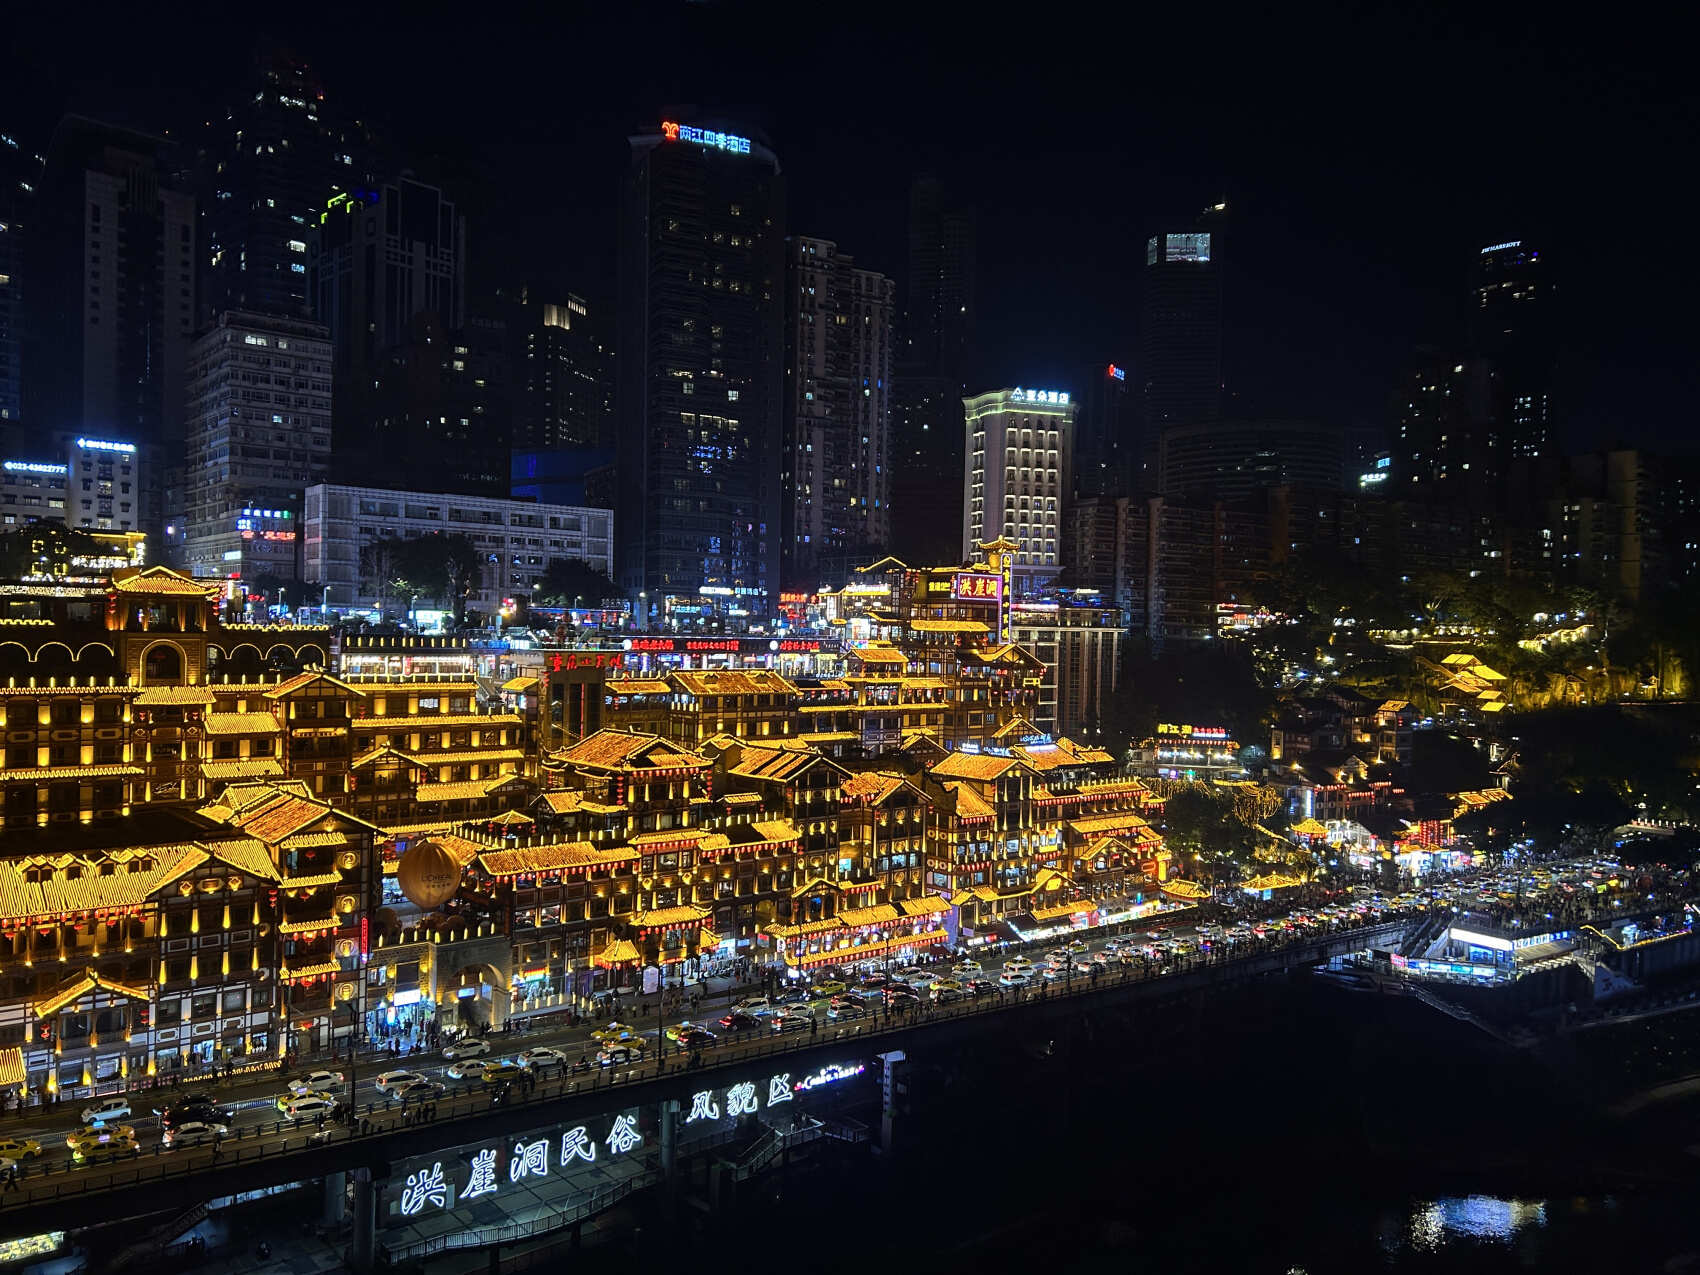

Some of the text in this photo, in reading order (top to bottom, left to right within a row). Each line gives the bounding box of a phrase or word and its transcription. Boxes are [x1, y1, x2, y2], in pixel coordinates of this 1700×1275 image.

[679, 124, 751, 154] 两江四季酒店
[960, 577, 998, 597] 洪崖洞
